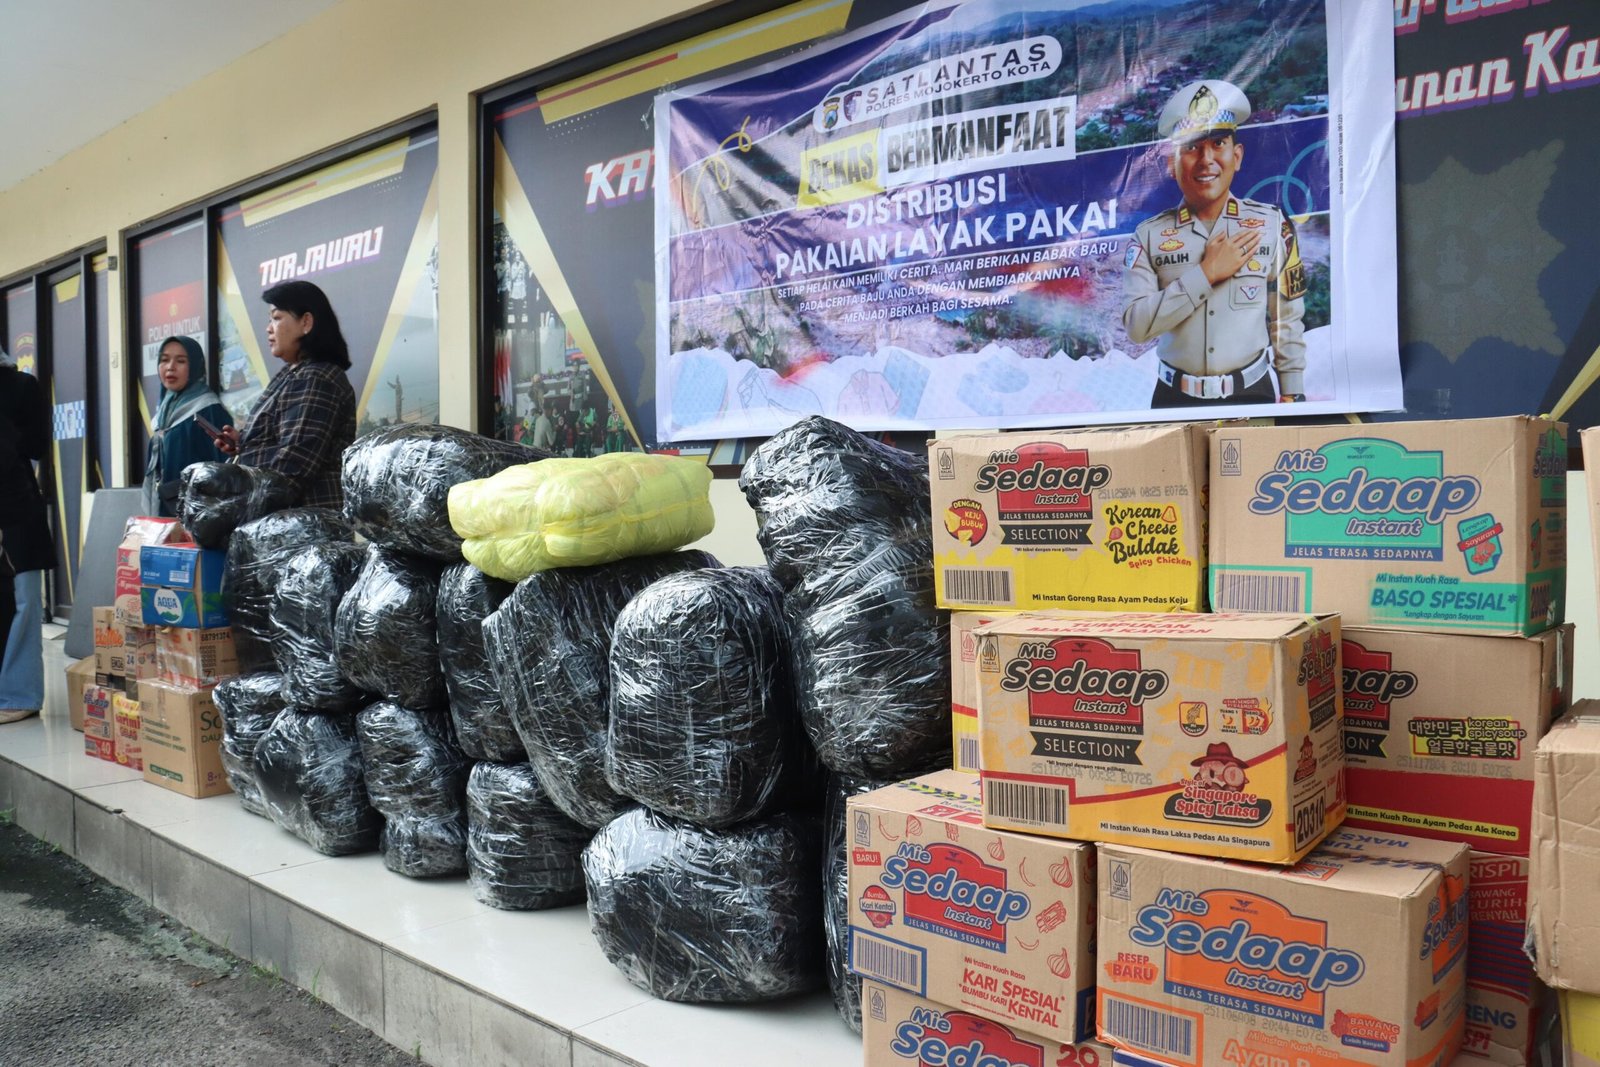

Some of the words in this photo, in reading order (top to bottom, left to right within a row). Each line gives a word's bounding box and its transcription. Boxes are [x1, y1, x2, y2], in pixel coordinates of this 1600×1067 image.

[866, 43, 1047, 104] SATLANTAS
[865, 93, 911, 114] POLRES
[914, 71, 1002, 101] MOJOKERTO
[1007, 61, 1051, 78] KOTA
[808, 141, 875, 194] BEKAS
[887, 105, 1071, 174] BERMANFAAT
[847, 173, 1007, 229] DISTRIBUSI
[775, 233, 888, 280] PAKAIAN
[891, 215, 998, 258] LAYAK
[1005, 200, 1118, 242] PAKAI
[1155, 253, 1190, 266] GALIH
[778, 285, 805, 299] SETIAP
[806, 281, 832, 295] HELAI
[833, 278, 856, 291] KAIN
[857, 271, 899, 287] MEMILIKI
[899, 265, 942, 280] CERITA.
[944, 259, 975, 275] MARI
[976, 253, 1031, 270] BERIKAN
[1033, 247, 1077, 264] BABAK
[1080, 241, 1119, 257] BARU
[800, 300, 824, 313] PADA
[825, 296, 859, 310] CERITA
[860, 291, 886, 305] BAJU
[887, 286, 916, 301] ANDA
[917, 279, 966, 297] DENGAN
[967, 266, 1081, 292] MEMBIARKANNYA
[844, 308, 889, 324] MENJADI
[890, 303, 930, 319] BERKAH
[931, 299, 958, 314] BAGI
[960, 294, 1014, 310] SESAMA.
[987, 449, 1020, 465] Mie
[1275, 450, 1328, 473] Mie
[974, 461, 1112, 495] Sedaap
[953, 500, 981, 510] DENGAN
[1034, 493, 1080, 505] Instant
[1248, 466, 1482, 524] Sedaap
[960, 520, 984, 529] BUBUK
[964, 511, 982, 520] KEJU
[1105, 505, 1162, 525] Korean
[1125, 520, 1177, 540] Cheese
[1345, 517, 1424, 537] Instant
[1465, 529, 1496, 547] Sayuran
[1109, 536, 1180, 564] Buldak
[1292, 547, 1324, 558] JELAS
[1328, 547, 1369, 558] TERASA
[1373, 548, 1435, 560] SEDAPNYA
[1128, 558, 1153, 569] Spicy
[1156, 556, 1192, 567] Chicken
[1376, 573, 1387, 583] Mi
[1388, 574, 1413, 584] Instan
[1414, 574, 1437, 584] Kuah
[1437, 575, 1460, 585] Rasa
[157, 597, 178, 609] AQUA
[1032, 593, 1041, 601] Mi
[1067, 594, 1096, 603] Goreng
[1097, 595, 1116, 603] Rasa
[1118, 596, 1141, 604] Ayam
[1142, 596, 1168, 604] Pedas
[1169, 596, 1188, 605] Keju
[1371, 588, 1426, 607] BASO
[1458, 612, 1485, 621] Sayuran
[1018, 641, 1057, 660] Mie
[1000, 658, 1169, 704] Sedaap
[1073, 698, 1128, 715] Instant
[1034, 718, 1058, 728] JELAS
[1060, 720, 1092, 731] TERASA
[1093, 722, 1138, 734] SEDAPNYA
[1409, 719, 1465, 736] 대한민국
[1467, 717, 1509, 728] korean
[1183, 786, 1257, 805] Singapore
[1175, 799, 1215, 818] Spicy
[1216, 803, 1260, 820] Laksa
[1354, 808, 1379, 819] Instan
[1379, 811, 1401, 822] Kuah
[1401, 813, 1421, 824] Rasa
[1422, 817, 1447, 830] Ayam
[1448, 820, 1473, 832] Pedas
[1474, 824, 1490, 834] Ala
[1490, 826, 1517, 838] Korea
[1100, 822, 1109, 830] Mi
[1110, 824, 1131, 832] Instan
[1132, 826, 1151, 834] Kuah
[1152, 828, 1169, 836] Rasa
[1170, 830, 1192, 838] Laksa
[1193, 832, 1216, 841] Pedas
[1217, 835, 1230, 843] Ala
[1231, 837, 1271, 848] Singapura
[856, 853, 879, 864] BARU!
[896, 841, 932, 864] Mie
[866, 891, 886, 900] Bumbu
[880, 856, 1031, 924] Sedaap
[861, 901, 874, 909] Kari
[874, 902, 894, 911] Kental
[1155, 887, 1209, 915] Mie
[943, 906, 995, 930] Instant
[908, 919, 929, 931] JELAS
[931, 925, 959, 938] TERASA
[961, 932, 1001, 950] SEDAPNYA
[1129, 904, 1366, 992] Sedaap
[964, 956, 973, 964] Mi
[973, 959, 992, 971] Instan
[992, 965, 1010, 976] Kuah
[1010, 970, 1026, 981] Rasa
[1116, 952, 1150, 966] RESEP
[963, 968, 998, 993] KARI
[1112, 962, 1154, 981] BARU
[1225, 967, 1306, 1001] Instant
[990, 993, 1008, 1007] KARI
[1007, 1000, 1059, 1028] KENTAL
[1171, 985, 1203, 1000] JELAS
[1207, 992, 1249, 1012] TERASA
[1253, 1003, 1315, 1026] SEDAPNYA
[910, 1006, 951, 1033] Mie
[1349, 1017, 1400, 1035] BAWANG
[1350, 1027, 1398, 1044] GORENG
